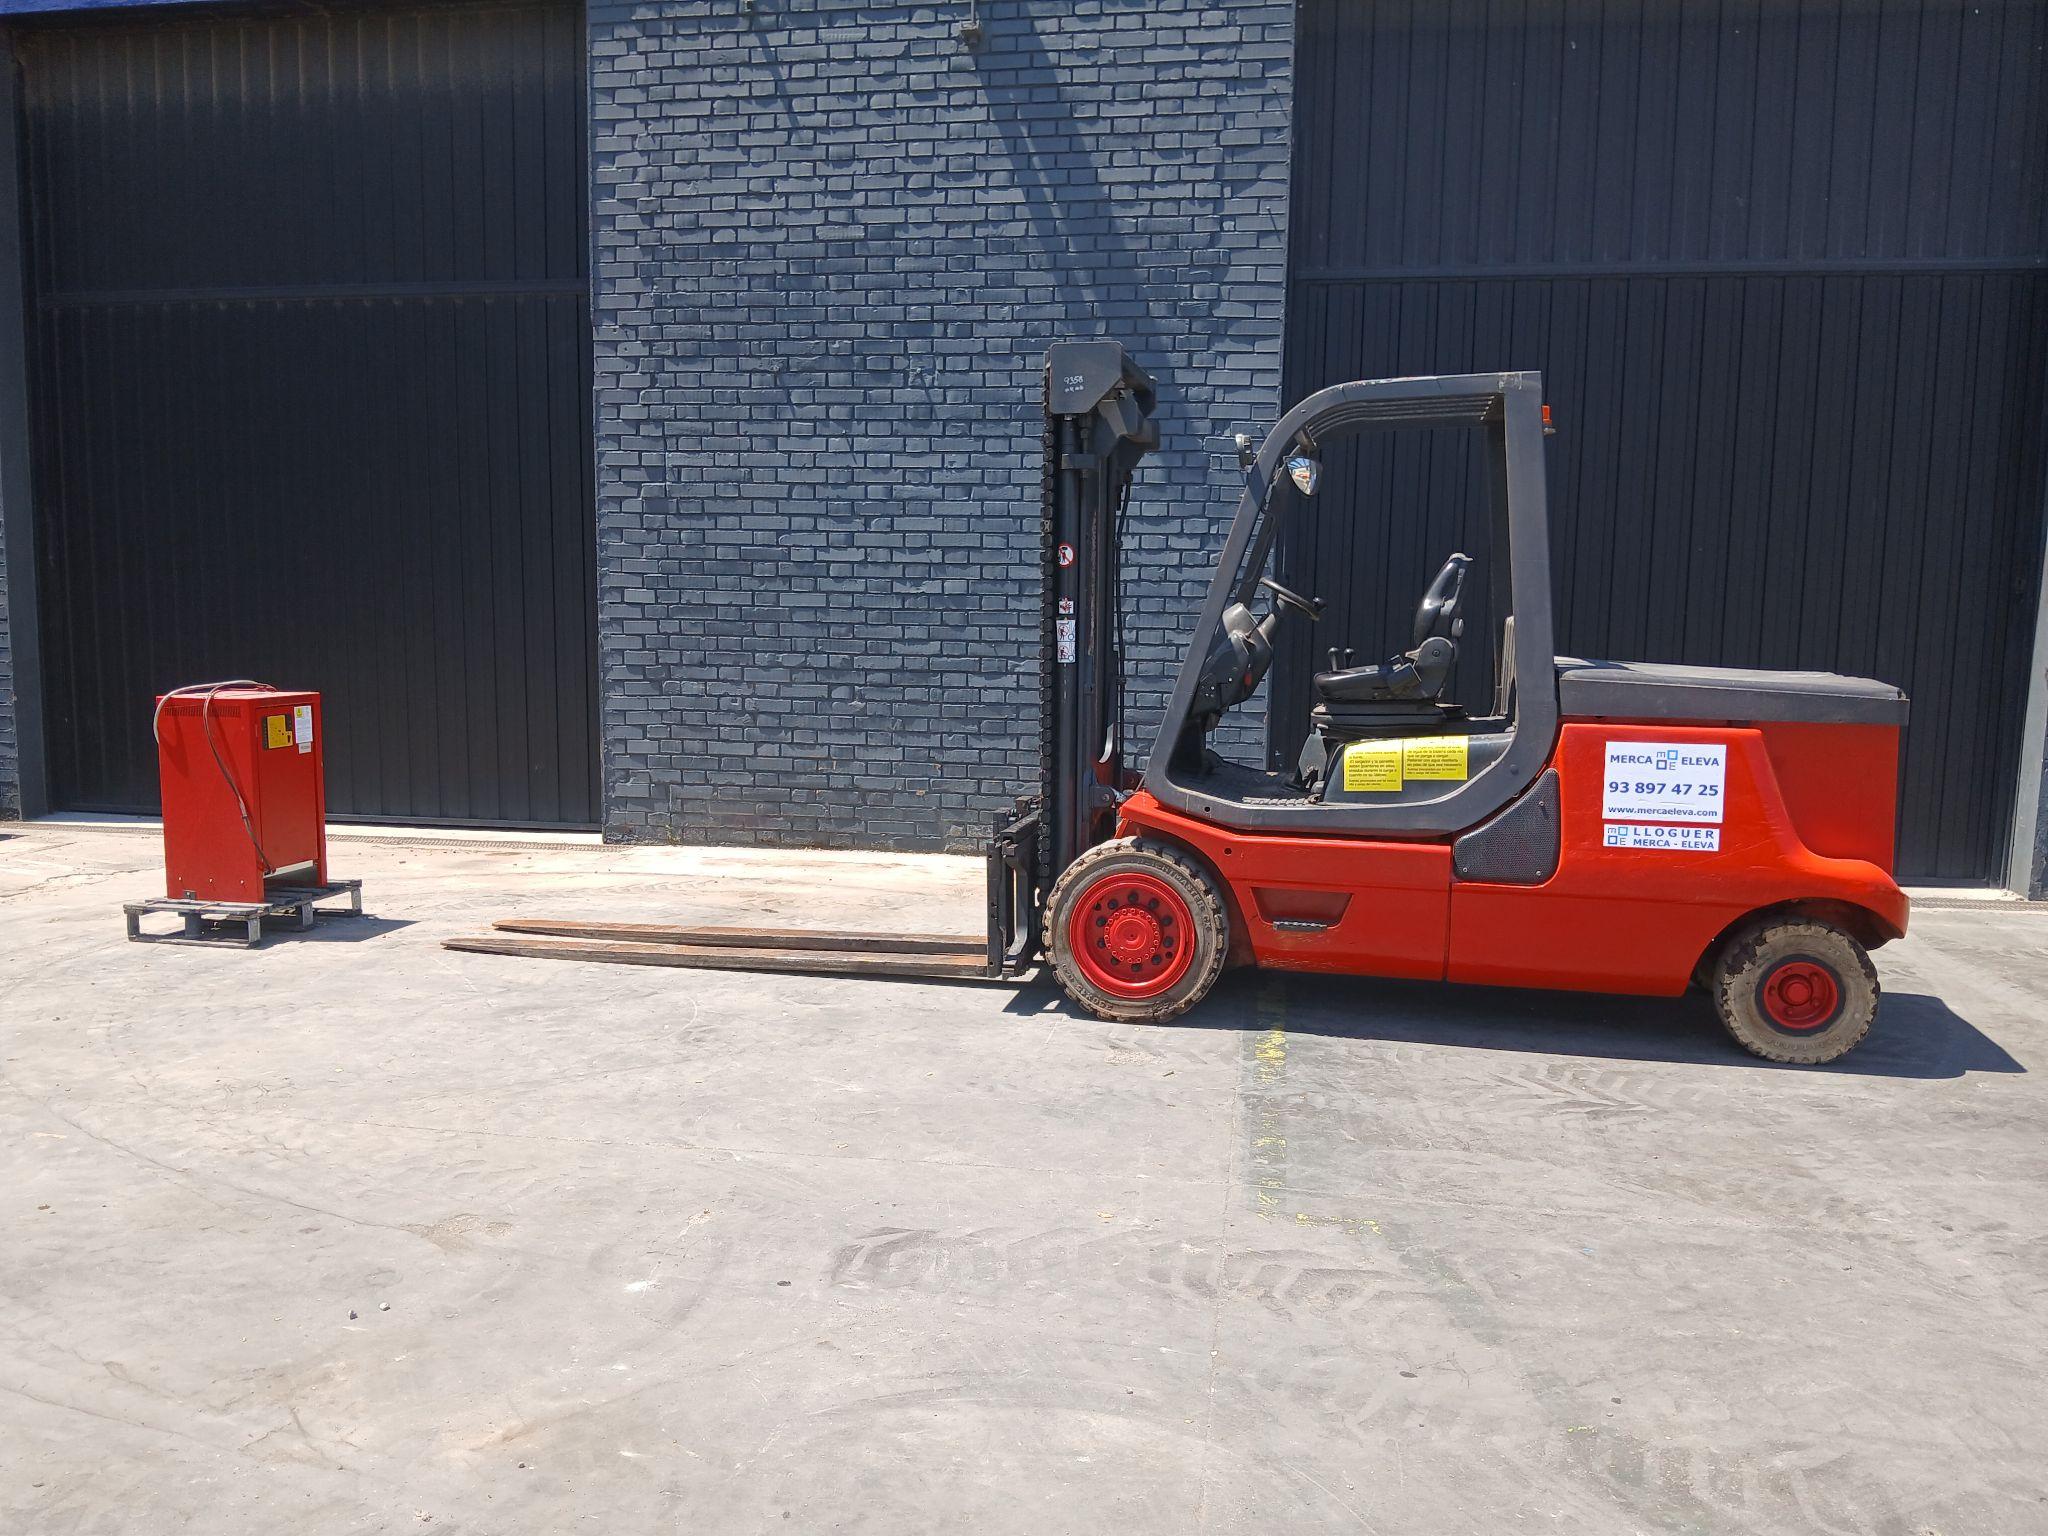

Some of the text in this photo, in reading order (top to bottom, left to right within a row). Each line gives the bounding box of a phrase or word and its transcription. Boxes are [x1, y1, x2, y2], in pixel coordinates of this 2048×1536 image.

[1610, 755, 1719, 766] MERCA ELEVA
[1609, 782, 1718, 796] 93 897 47 25
[1608, 807, 1717, 816] www.mercaeleva.com
[1633, 839, 1670, 847] MERCA
[1681, 841, 1714, 849] ELEVA
